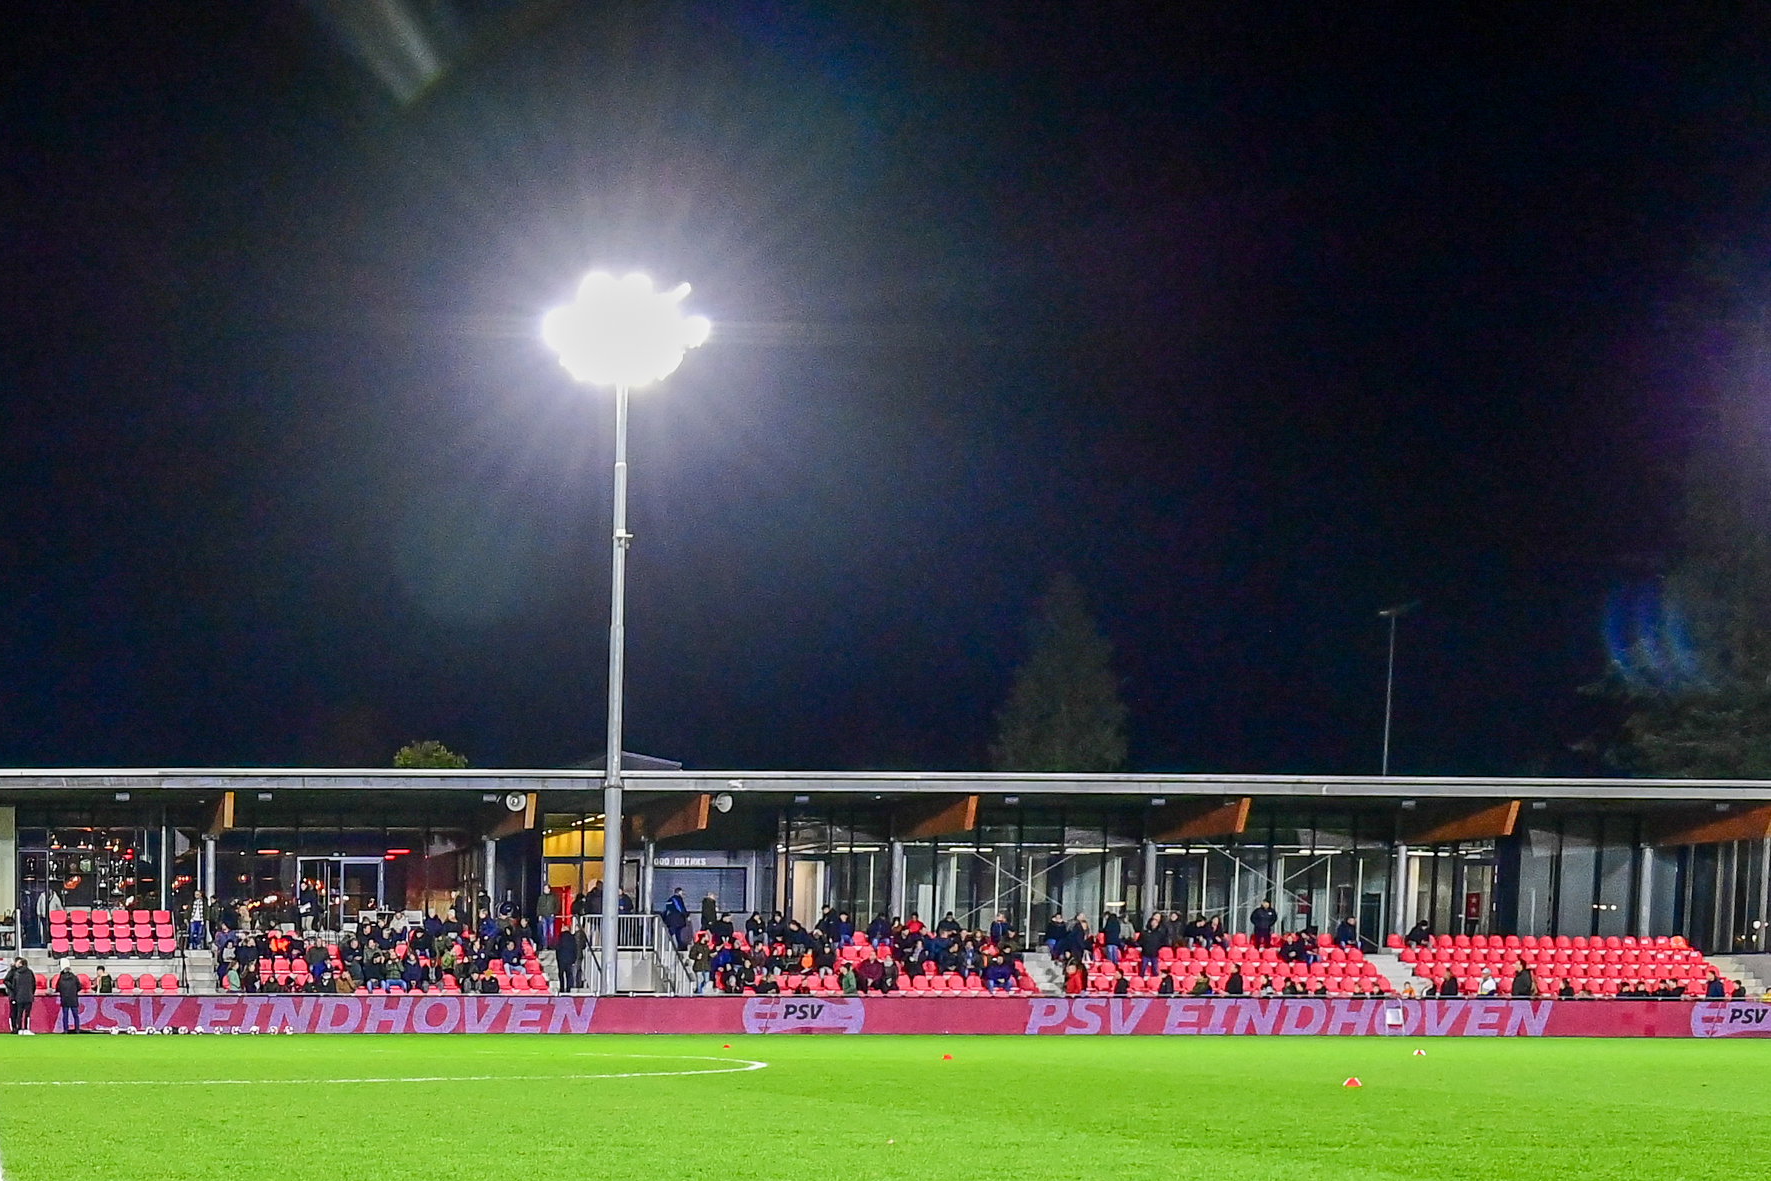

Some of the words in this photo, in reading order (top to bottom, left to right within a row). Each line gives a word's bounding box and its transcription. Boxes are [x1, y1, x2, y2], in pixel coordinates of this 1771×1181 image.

[654, 857, 670, 866] OOD
[195, 996, 597, 1034] EINDHOVEN
[783, 1004, 825, 1019] PSV
[1025, 998, 1154, 1035] PSV
[1163, 998, 1554, 1036] EINDHOVEN
[1729, 1008, 1769, 1023] PSV
